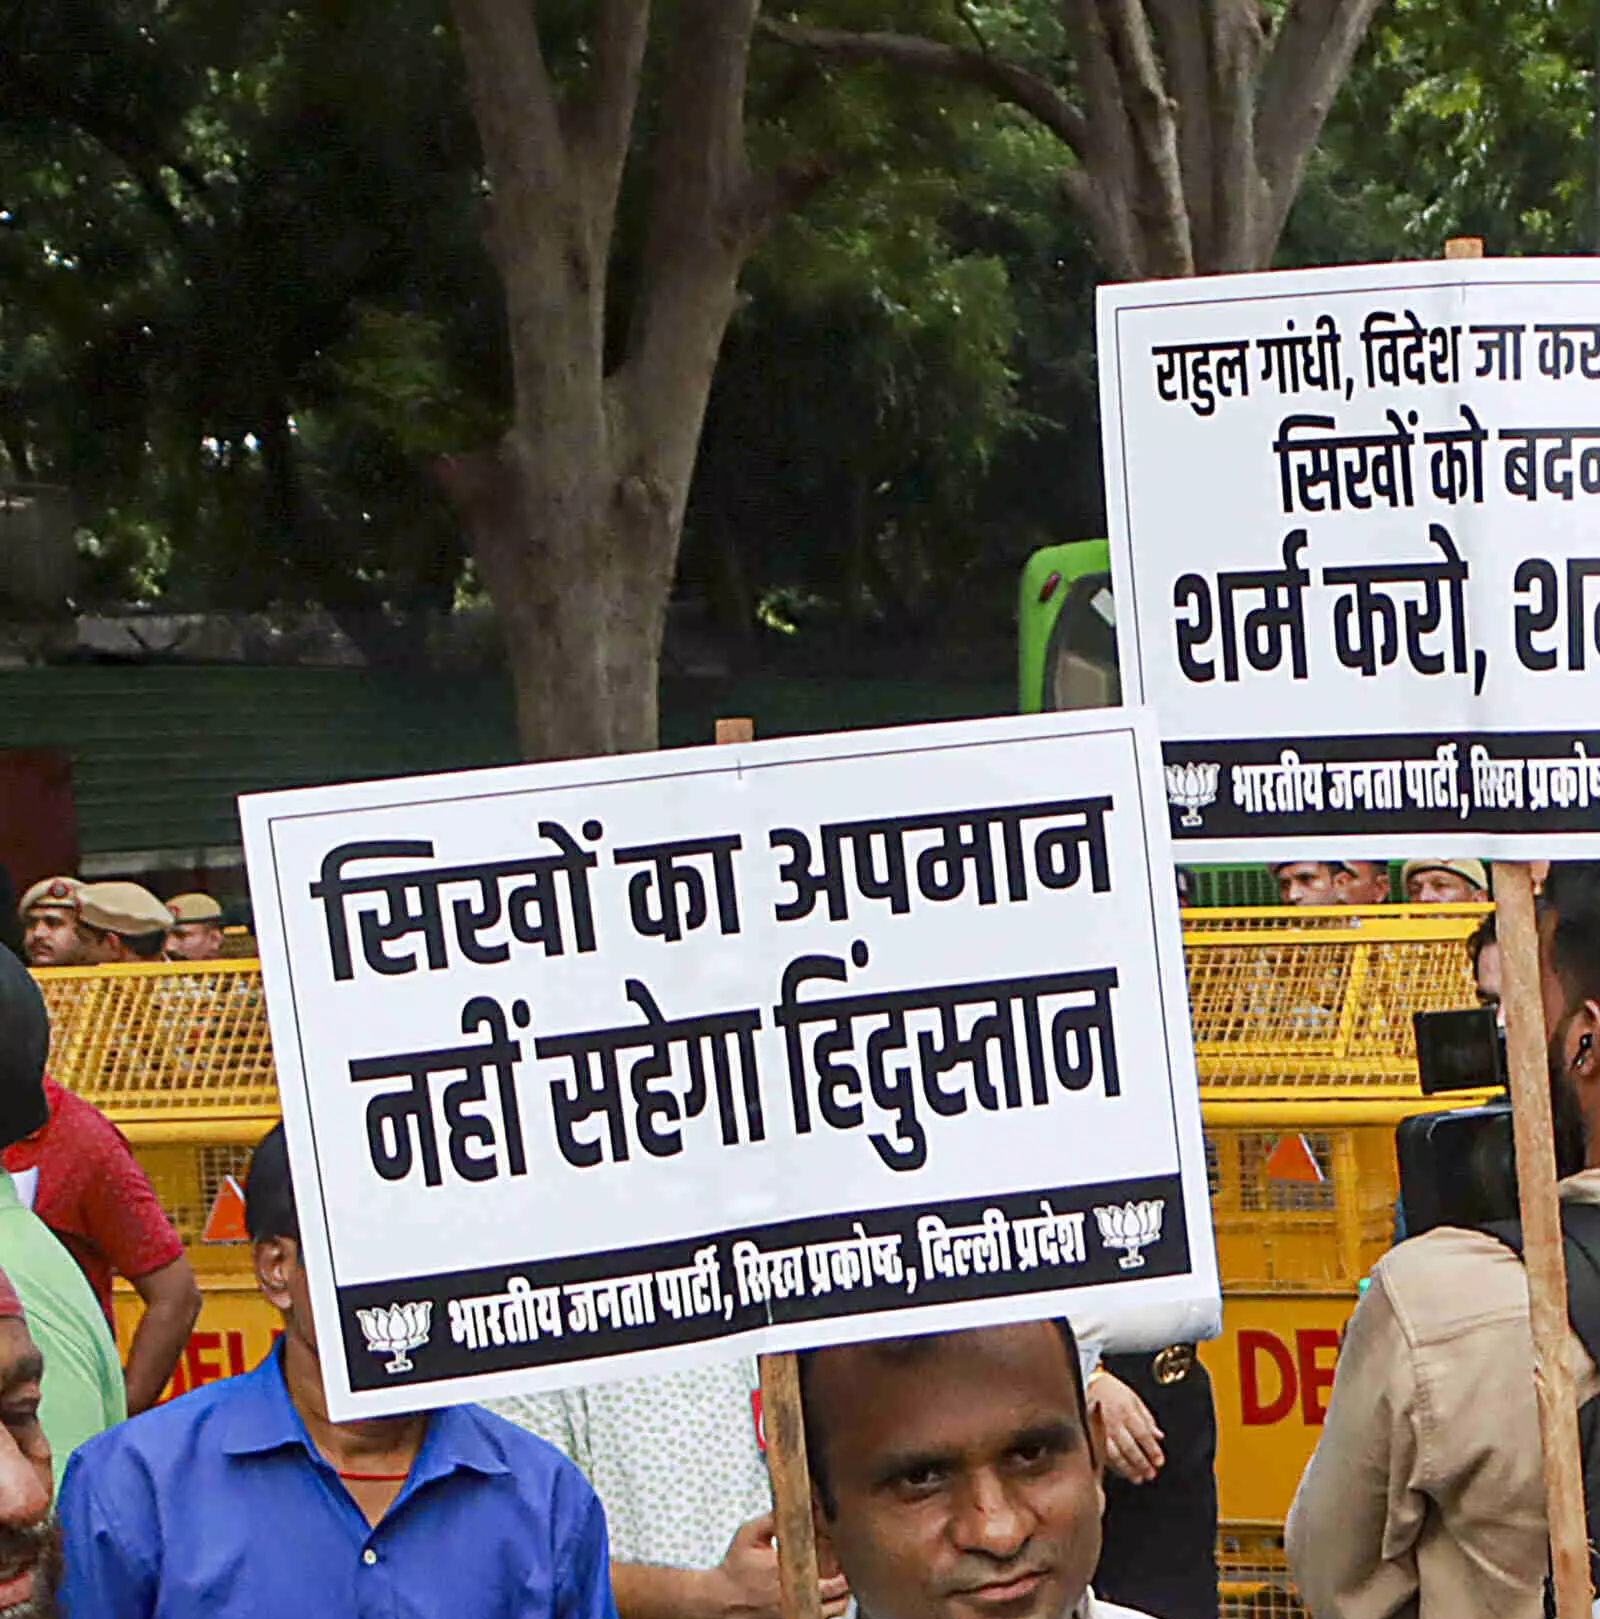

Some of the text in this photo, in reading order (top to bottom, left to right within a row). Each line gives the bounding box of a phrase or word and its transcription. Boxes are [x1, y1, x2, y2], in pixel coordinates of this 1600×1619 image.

[1152, 340, 1249, 416] राहुल
[1256, 315, 1353, 400] गांधी,
[1360, 309, 1461, 388] विदेश
[1467, 324, 1523, 381] जा
[1273, 409, 1418, 512] सिखों
[1424, 405, 1488, 504] को
[1174, 529, 1310, 682] शर्म
[1323, 524, 1486, 696] करो,
[1232, 750, 1323, 812] भारतीय
[1326, 761, 1402, 809] जनता
[1404, 743, 1468, 818] पार्टी,
[1471, 745, 1524, 808] सिख
[310, 796, 1114, 981] सिखों का अपमान
[349, 940, 1120, 1187] नहीं सहेगा हिंदुस्तान
[448, 1201, 1085, 1348] भारतीय जनता पार्टी, सिख प्रकोष्ठ, दिल्ली प्रदेश
